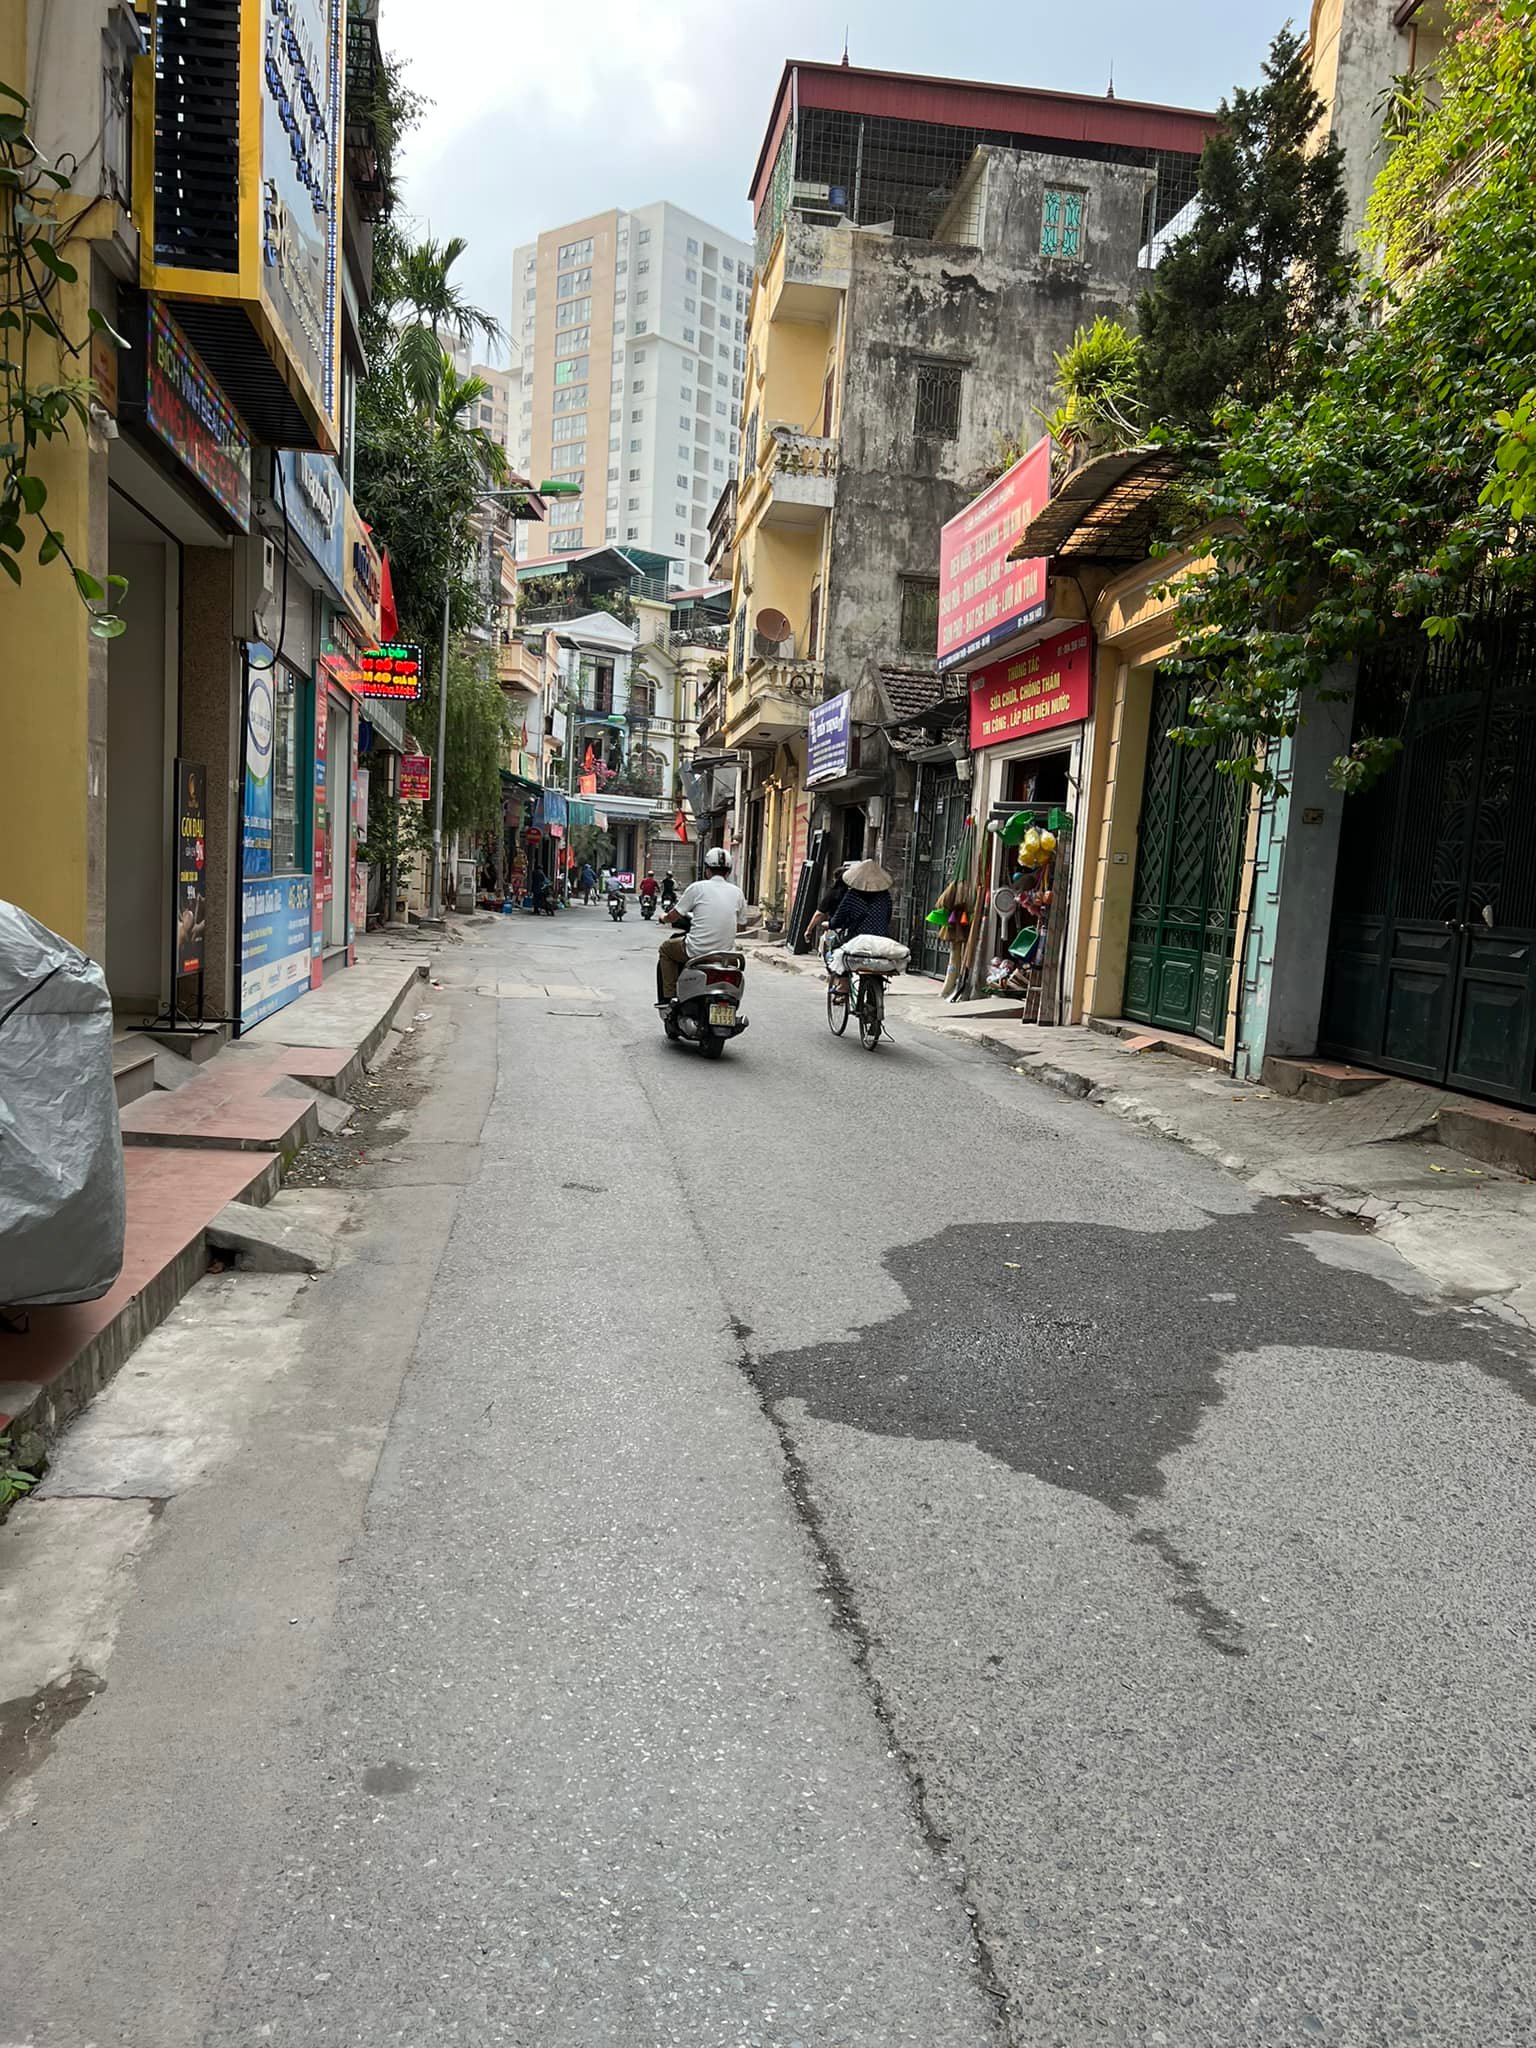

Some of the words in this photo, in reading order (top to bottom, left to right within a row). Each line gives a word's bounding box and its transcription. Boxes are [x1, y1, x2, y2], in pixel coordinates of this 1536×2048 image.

[991, 715, 1007, 733] CÔNG
[1010, 709, 1021, 728] LẮP
[1034, 700, 1050, 720] ĐIỆN
[1051, 692, 1070, 715] NƯỚC
